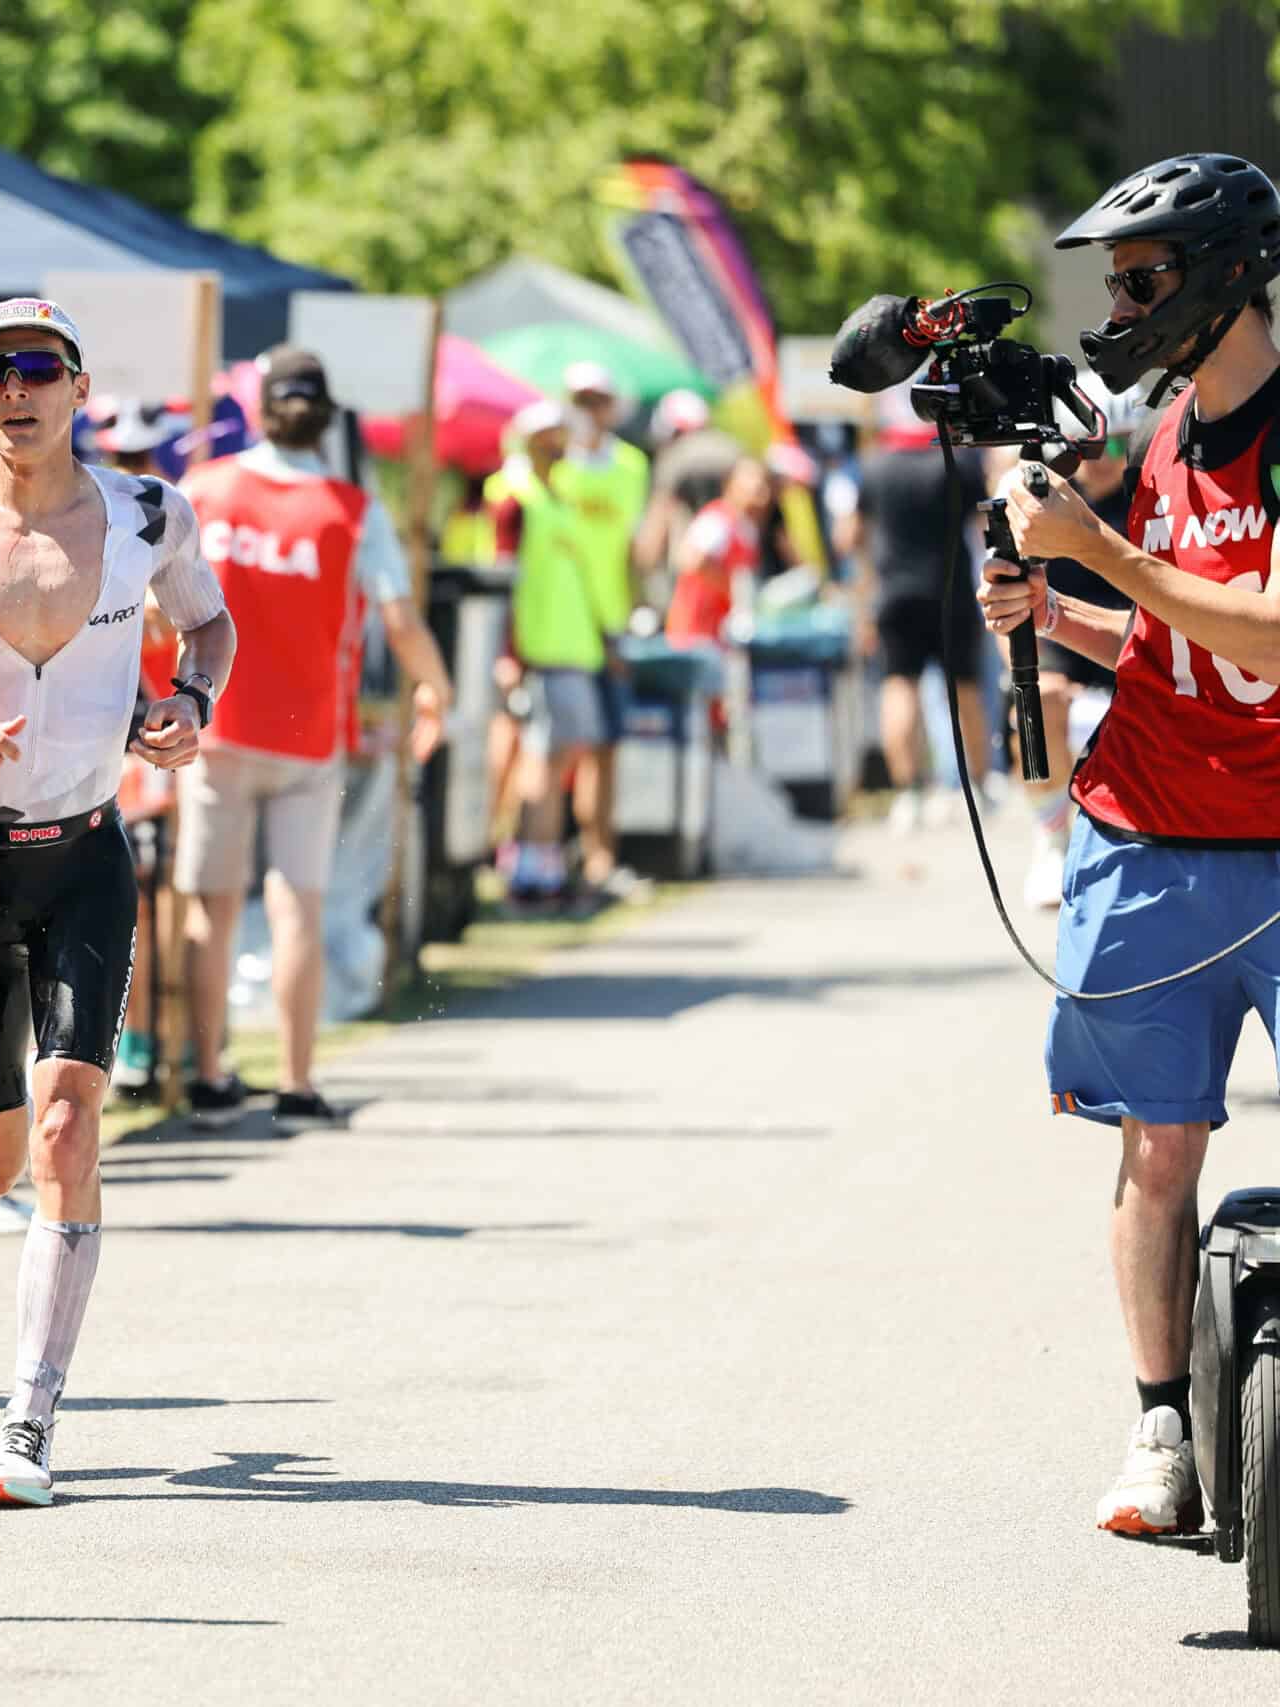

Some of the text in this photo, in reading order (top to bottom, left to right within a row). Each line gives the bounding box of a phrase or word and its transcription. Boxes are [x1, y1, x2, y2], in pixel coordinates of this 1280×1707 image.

[1179, 505, 1266, 548] NOW
[201, 520, 319, 579] COLA
[9, 825, 62, 842] NO PINZ
